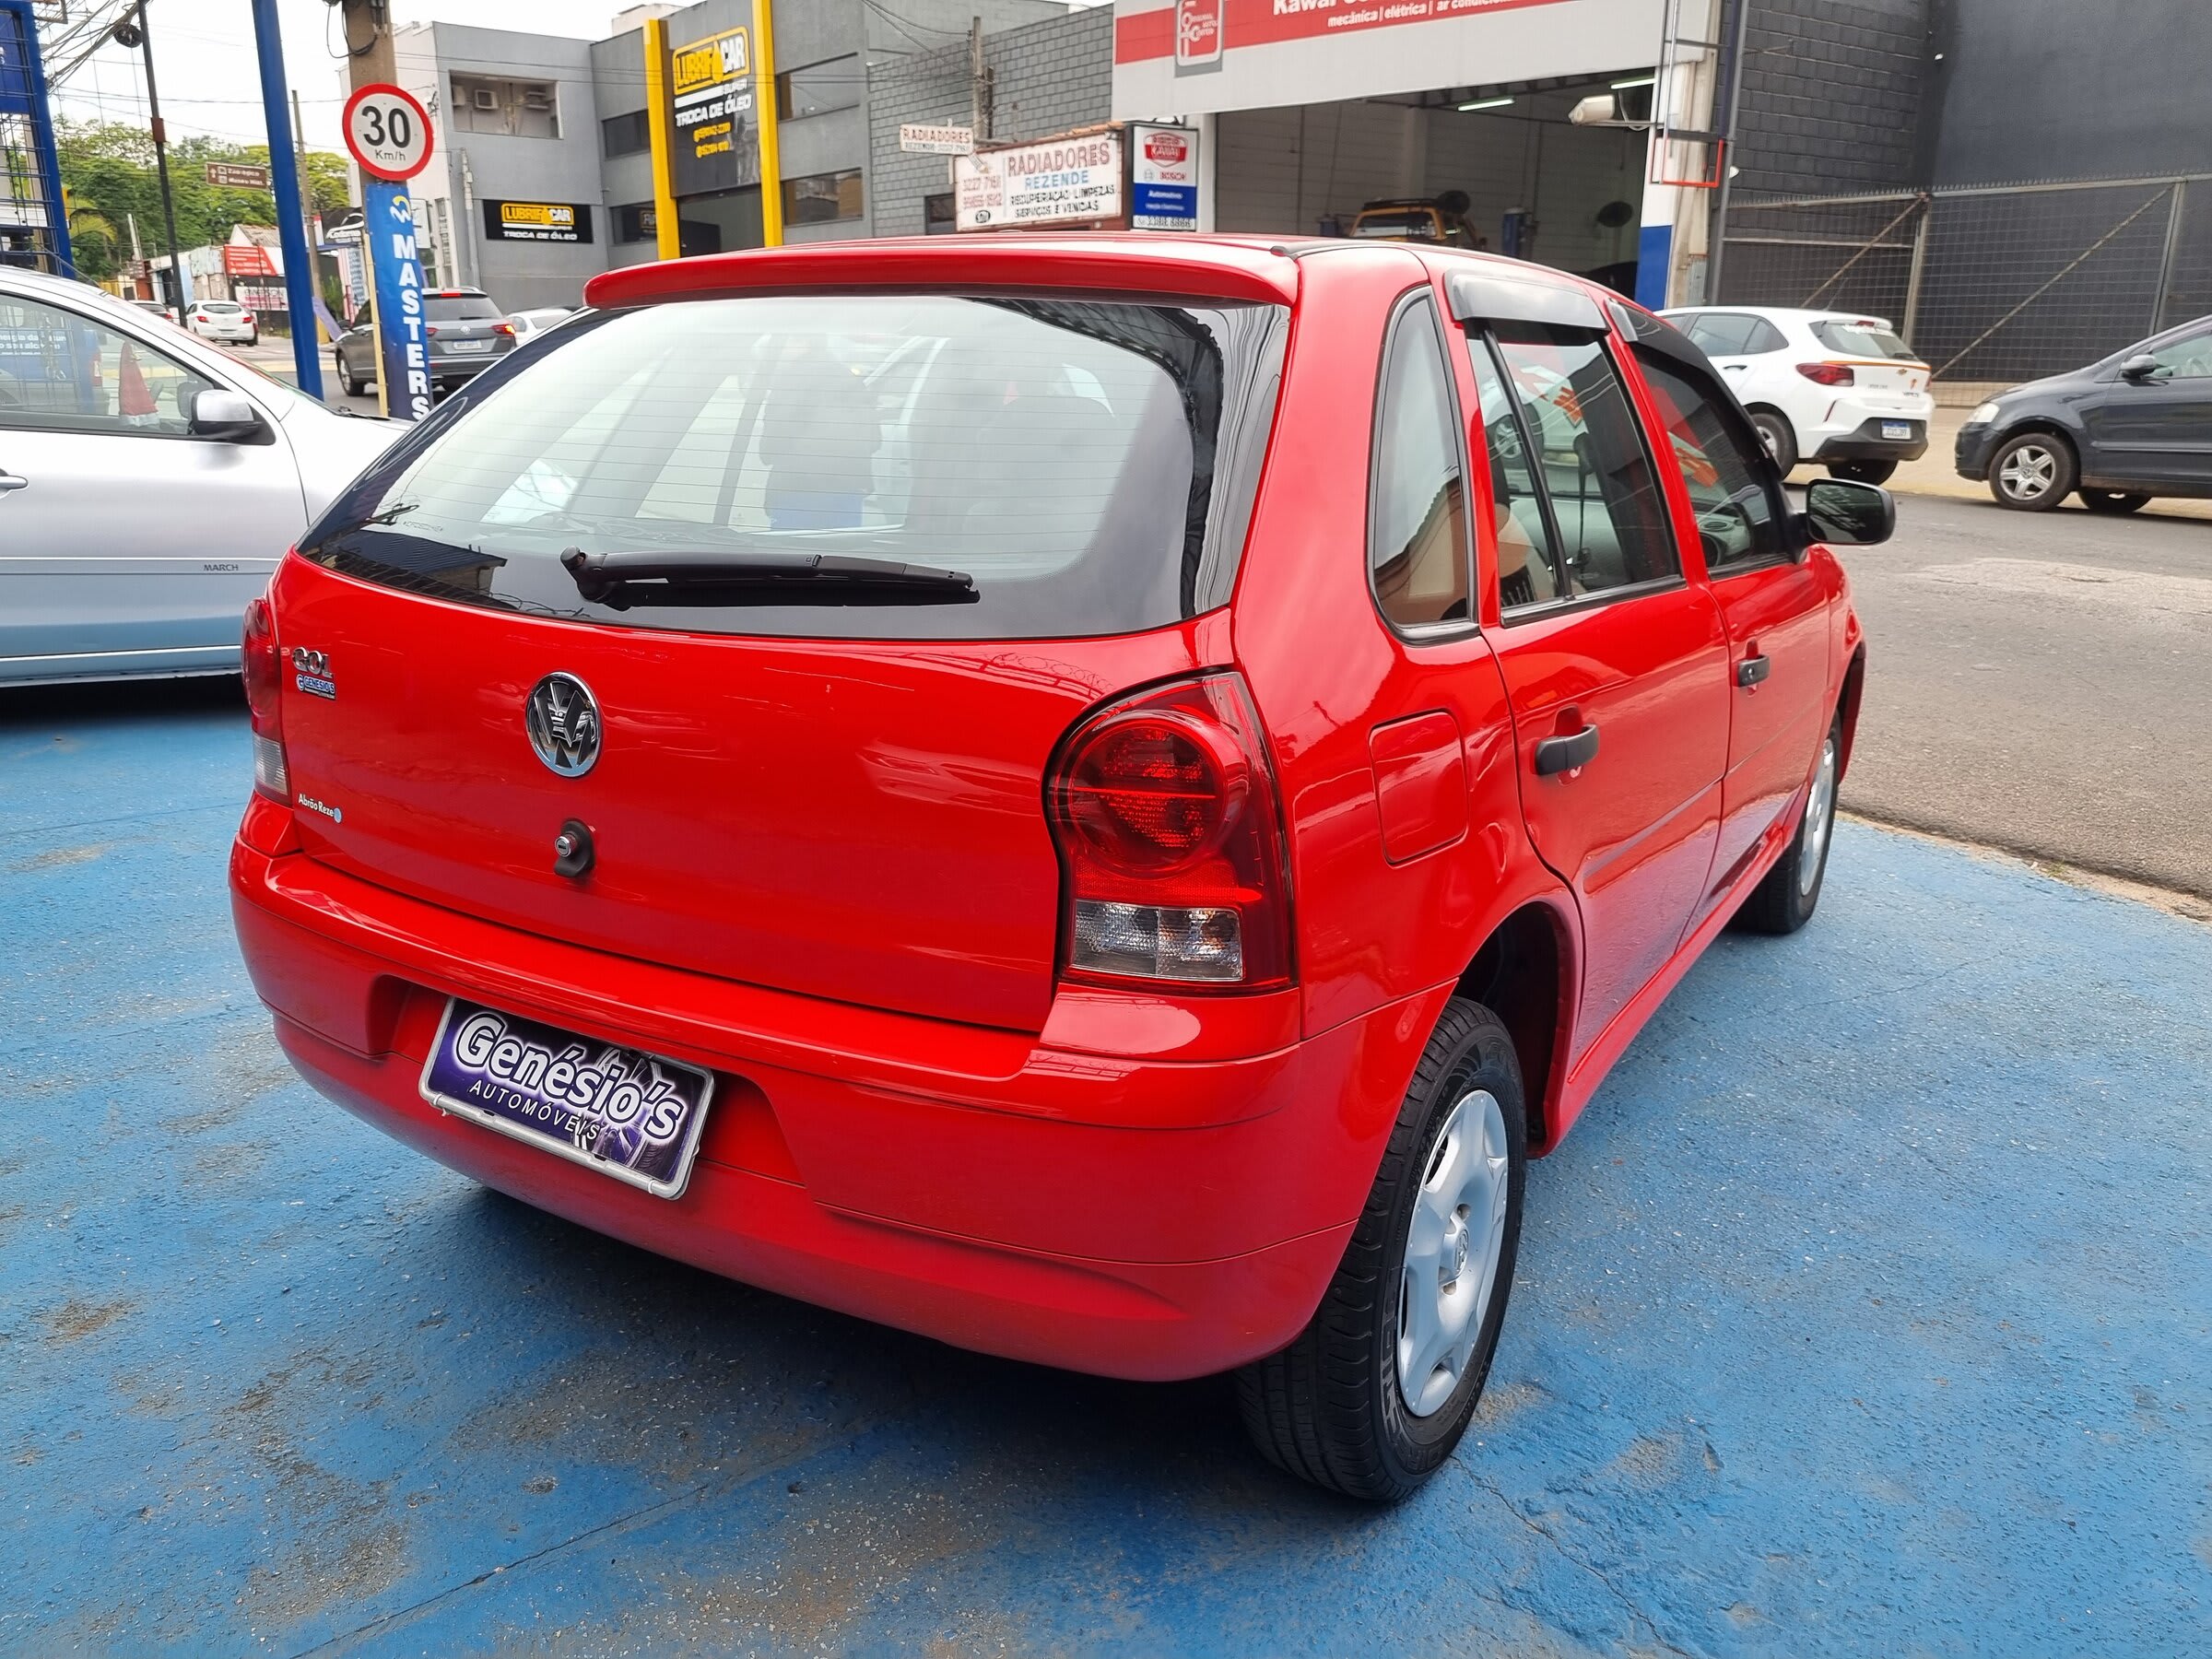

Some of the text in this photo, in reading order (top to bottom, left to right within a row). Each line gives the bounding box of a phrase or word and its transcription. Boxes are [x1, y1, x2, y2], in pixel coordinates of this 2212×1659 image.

[1328, 9, 1379, 28] mecânica
[1384, 3, 1427, 18] elétrica
[675, 93, 752, 127] TROCA DE ÓLEO
[361, 105, 410, 148] 30
[374, 149, 406, 161] Km/h
[1008, 142, 1110, 177] RADIADORES
[1025, 170, 1089, 191] REZENDE
[503, 229, 535, 239] TROCA
[550, 229, 578, 241] ÓLEO
[392, 234, 431, 421] MASTERS
[292, 647, 333, 678] GOL
[299, 794, 335, 818] Abrão Reze
[456, 1013, 686, 1139] Genésio's
[469, 1079, 600, 1141] AUTOMÓVEIS
